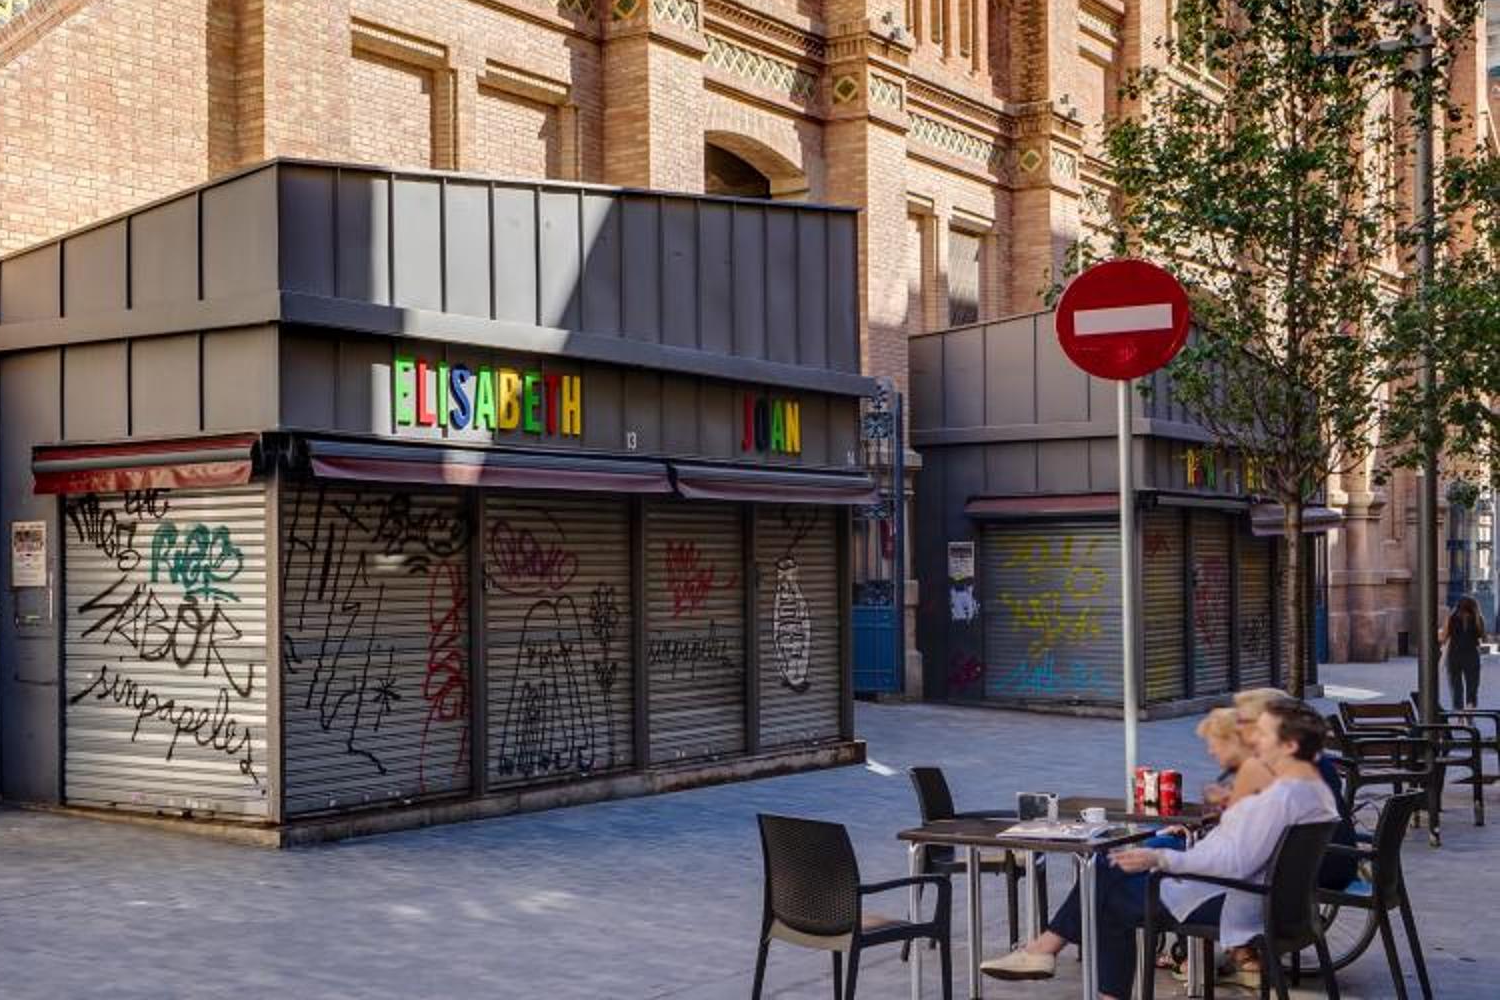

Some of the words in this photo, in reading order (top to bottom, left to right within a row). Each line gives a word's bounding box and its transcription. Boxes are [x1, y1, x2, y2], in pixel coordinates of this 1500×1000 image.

[395, 353, 582, 438] ELISABETH
[742, 391, 802, 456] JOAN
[626, 431, 637, 450] 13
